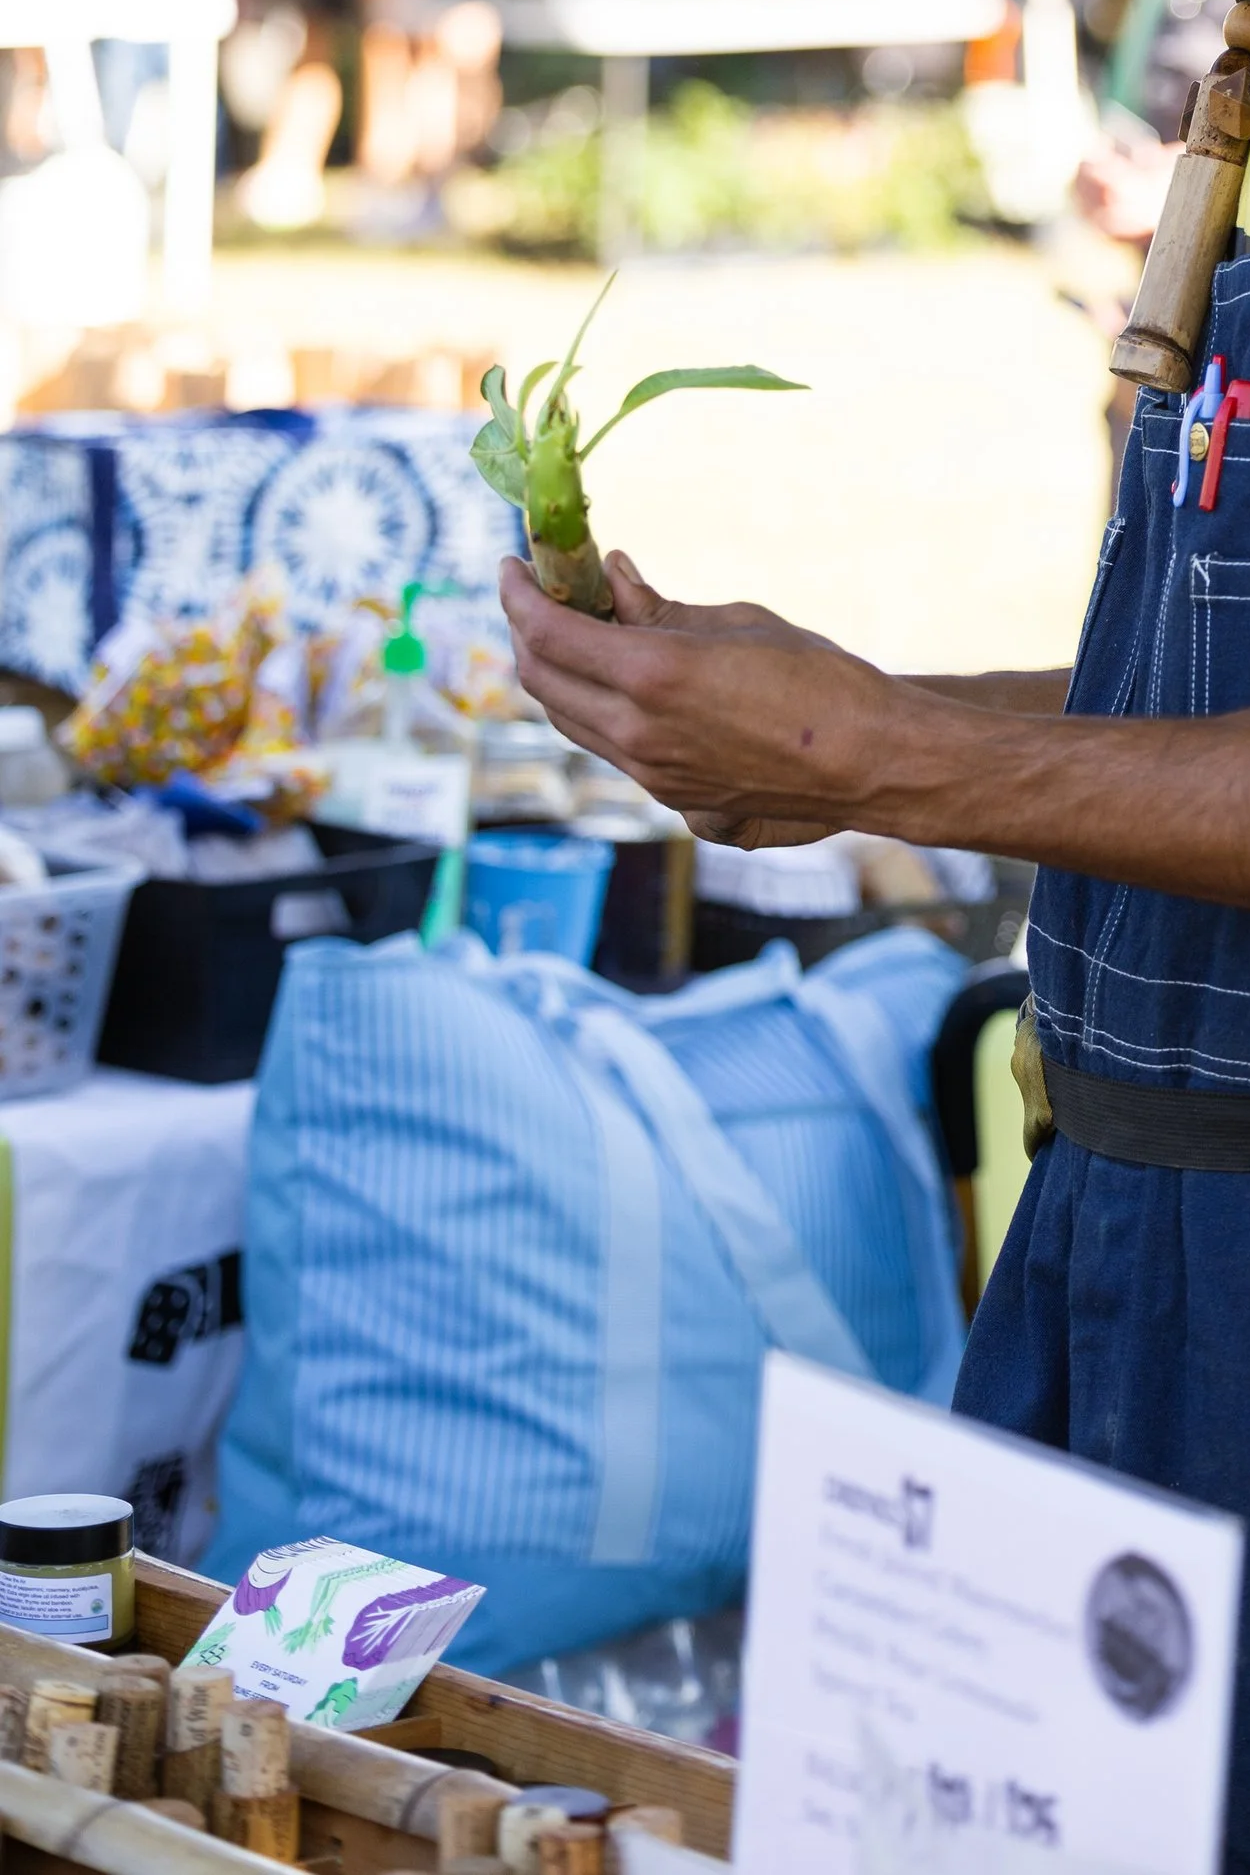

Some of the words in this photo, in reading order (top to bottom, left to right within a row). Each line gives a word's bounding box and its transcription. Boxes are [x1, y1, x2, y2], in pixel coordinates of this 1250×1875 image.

[250, 1660, 272, 1674] EVERY
[271, 1668, 308, 1687] SATURDAY
[260, 1679, 280, 1692] FROM
